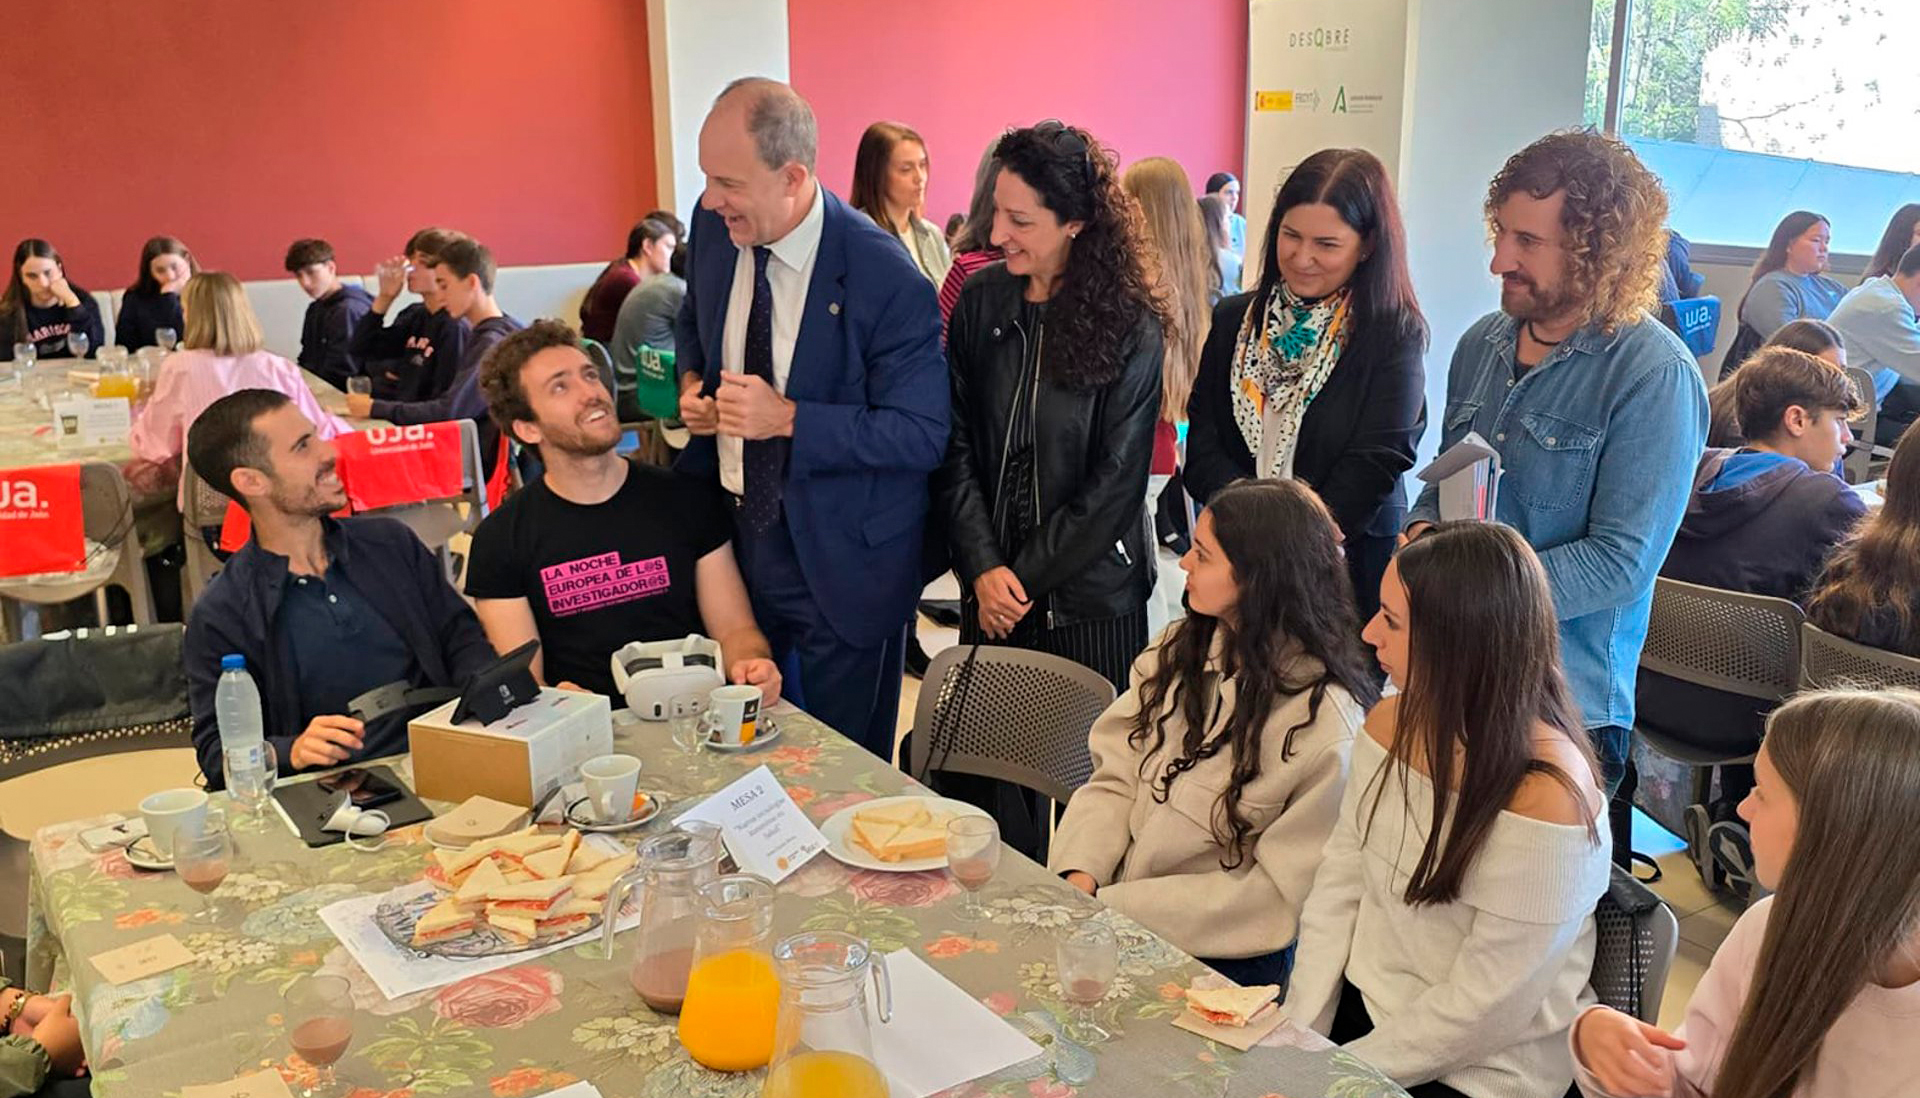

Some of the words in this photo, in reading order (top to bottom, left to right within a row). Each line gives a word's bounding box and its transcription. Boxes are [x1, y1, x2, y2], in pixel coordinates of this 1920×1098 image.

[1289, 28, 1350, 48] DESQBRE
[544, 568, 563, 581] LA
[569, 554, 618, 575] NOCHE
[548, 572, 611, 596] EUROPEA
[616, 566, 633, 580] DE
[636, 559, 664, 575] L@S
[551, 574, 667, 611] INVESTIGADOR@S
[730, 789, 758, 811] MESA
[755, 784, 765, 796] 2
